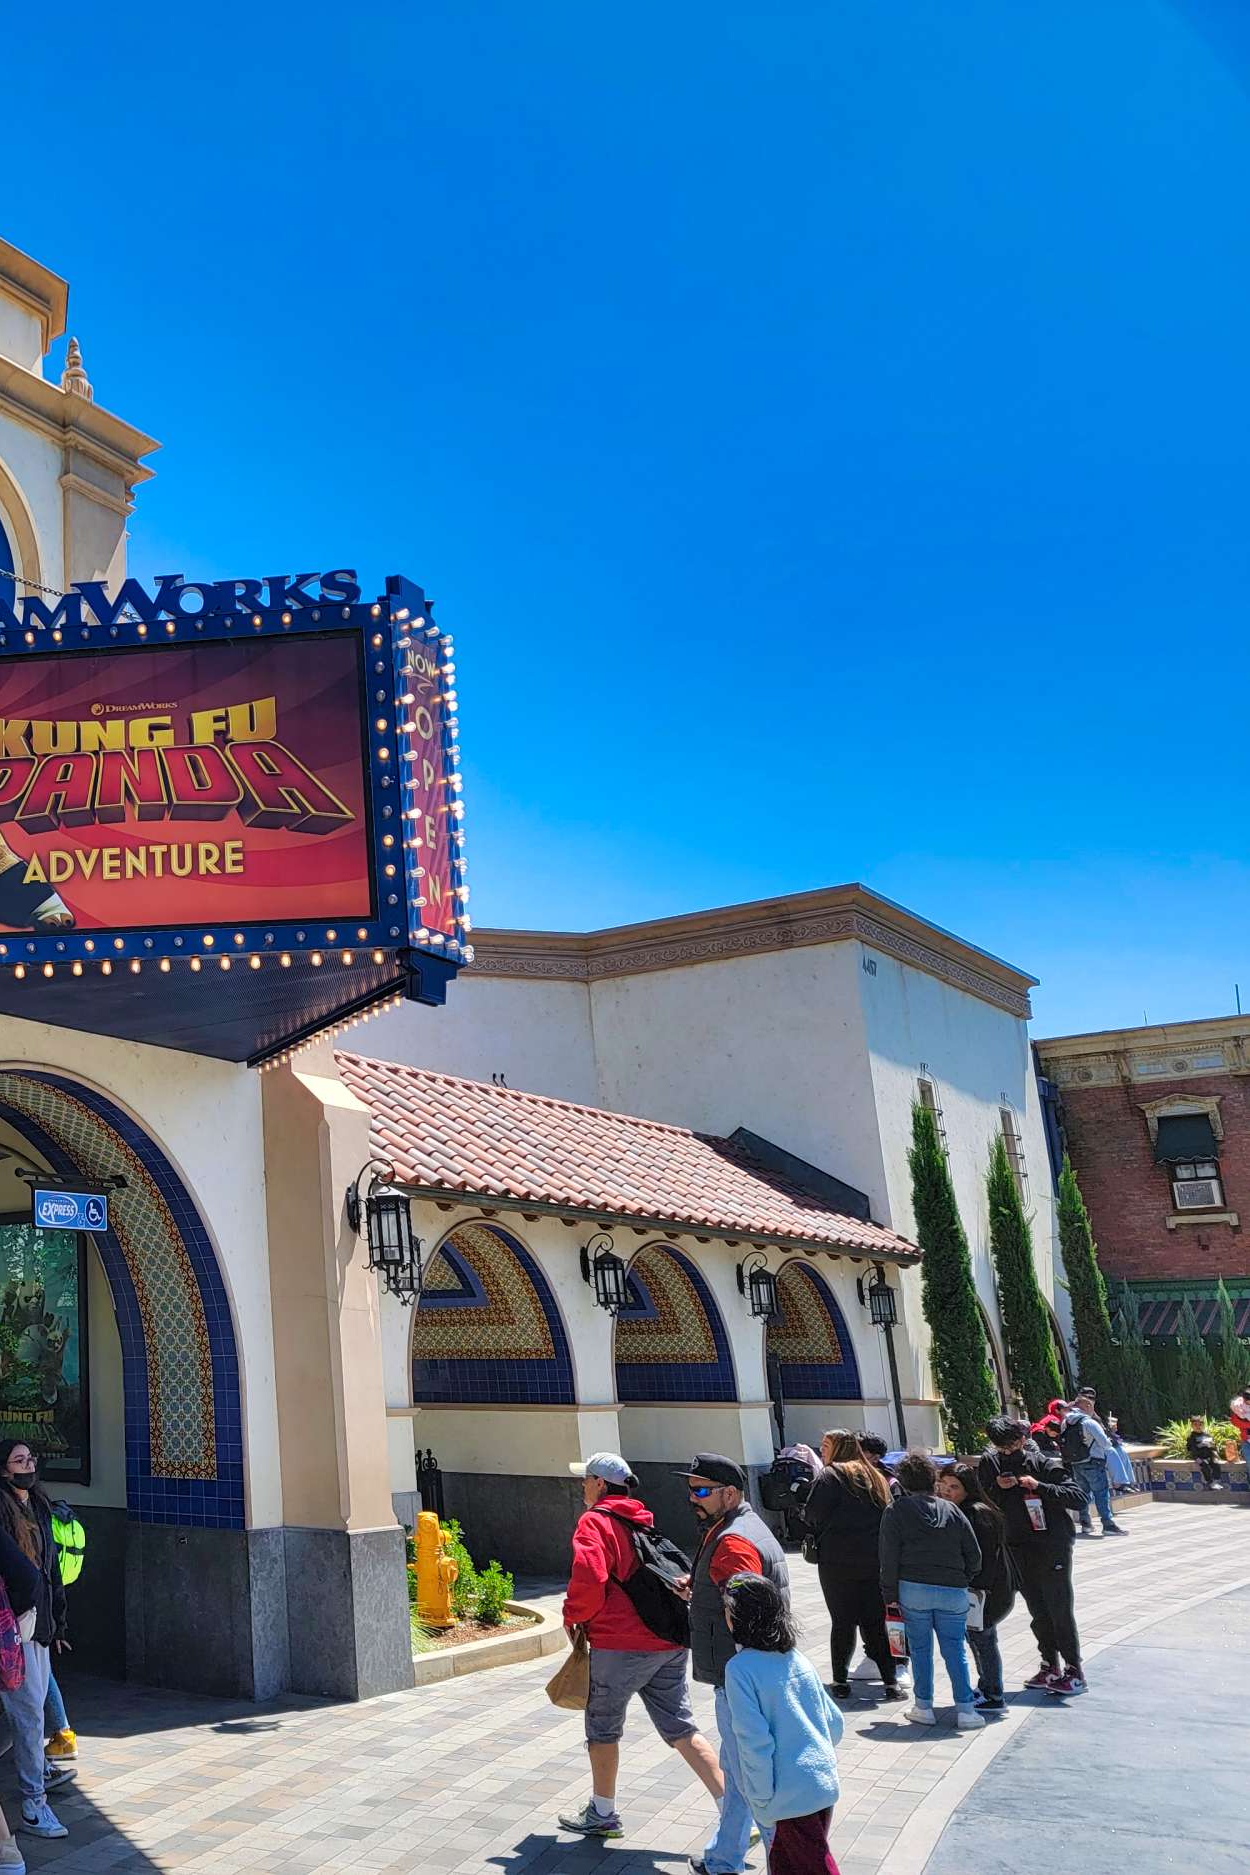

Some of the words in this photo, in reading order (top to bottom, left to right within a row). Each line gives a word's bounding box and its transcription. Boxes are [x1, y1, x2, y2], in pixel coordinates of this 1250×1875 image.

[406, 650, 436, 678] NOW
[190, 695, 277, 744] FU
[415, 705, 442, 907] OPEN
[22, 840, 245, 884] ADVENTURE
[42, 1202, 74, 1221] EXPRESS
